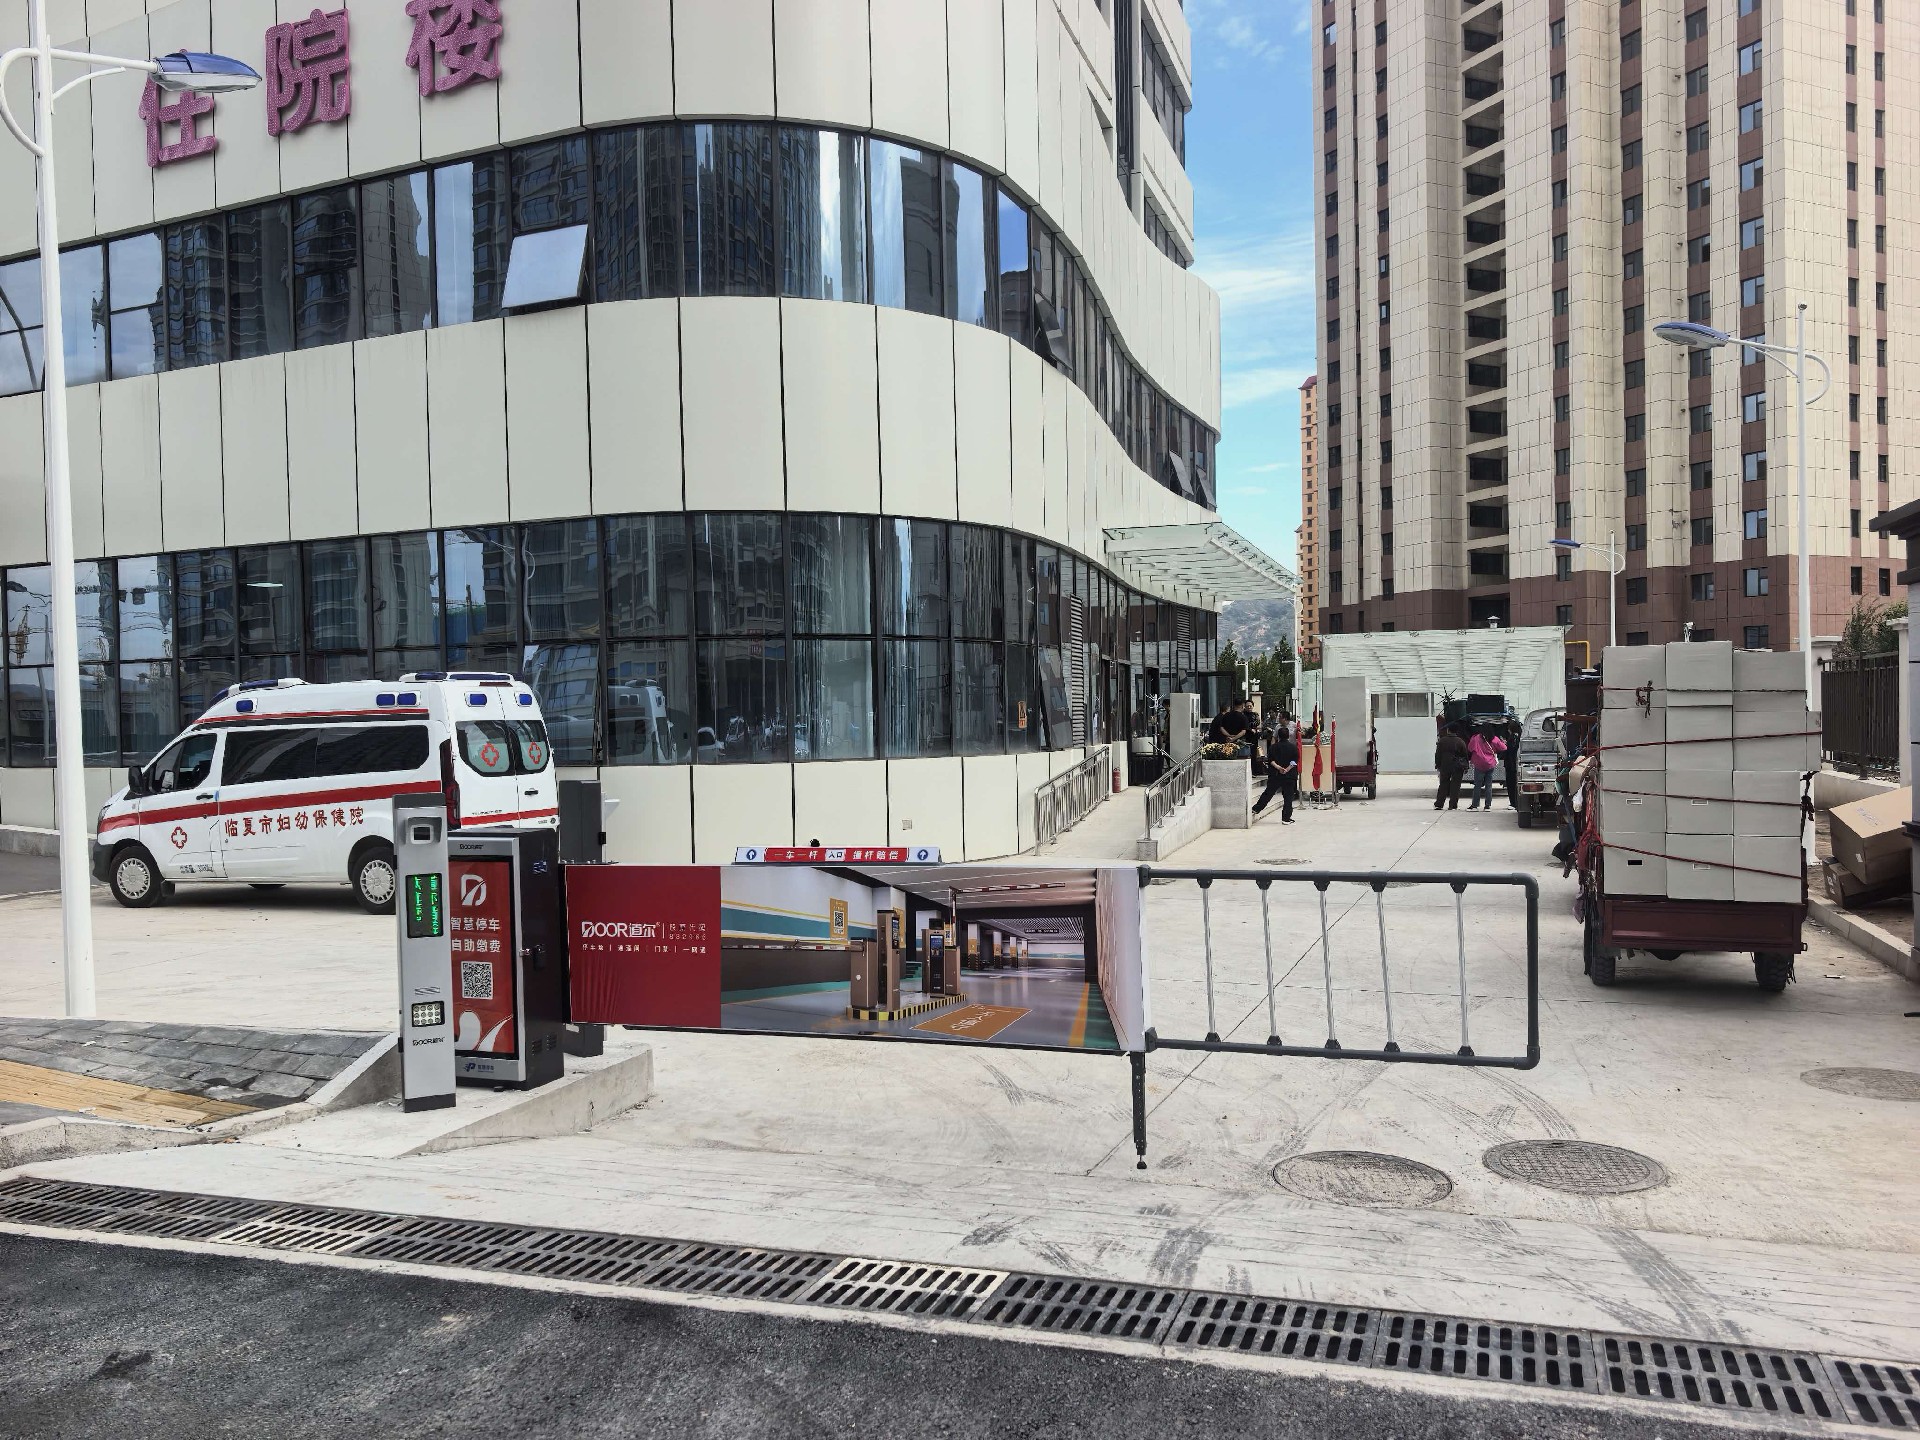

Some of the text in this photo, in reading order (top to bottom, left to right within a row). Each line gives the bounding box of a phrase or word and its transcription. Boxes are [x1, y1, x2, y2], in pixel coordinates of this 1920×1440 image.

[224, 806, 364, 837] 临夏市妇幼保健院
[774, 850, 819, 860] 一车一杆
[828, 851, 843, 859] 入口
[450, 917, 501, 932] 智慧停车
[451, 938, 501, 953] 自助缴费
